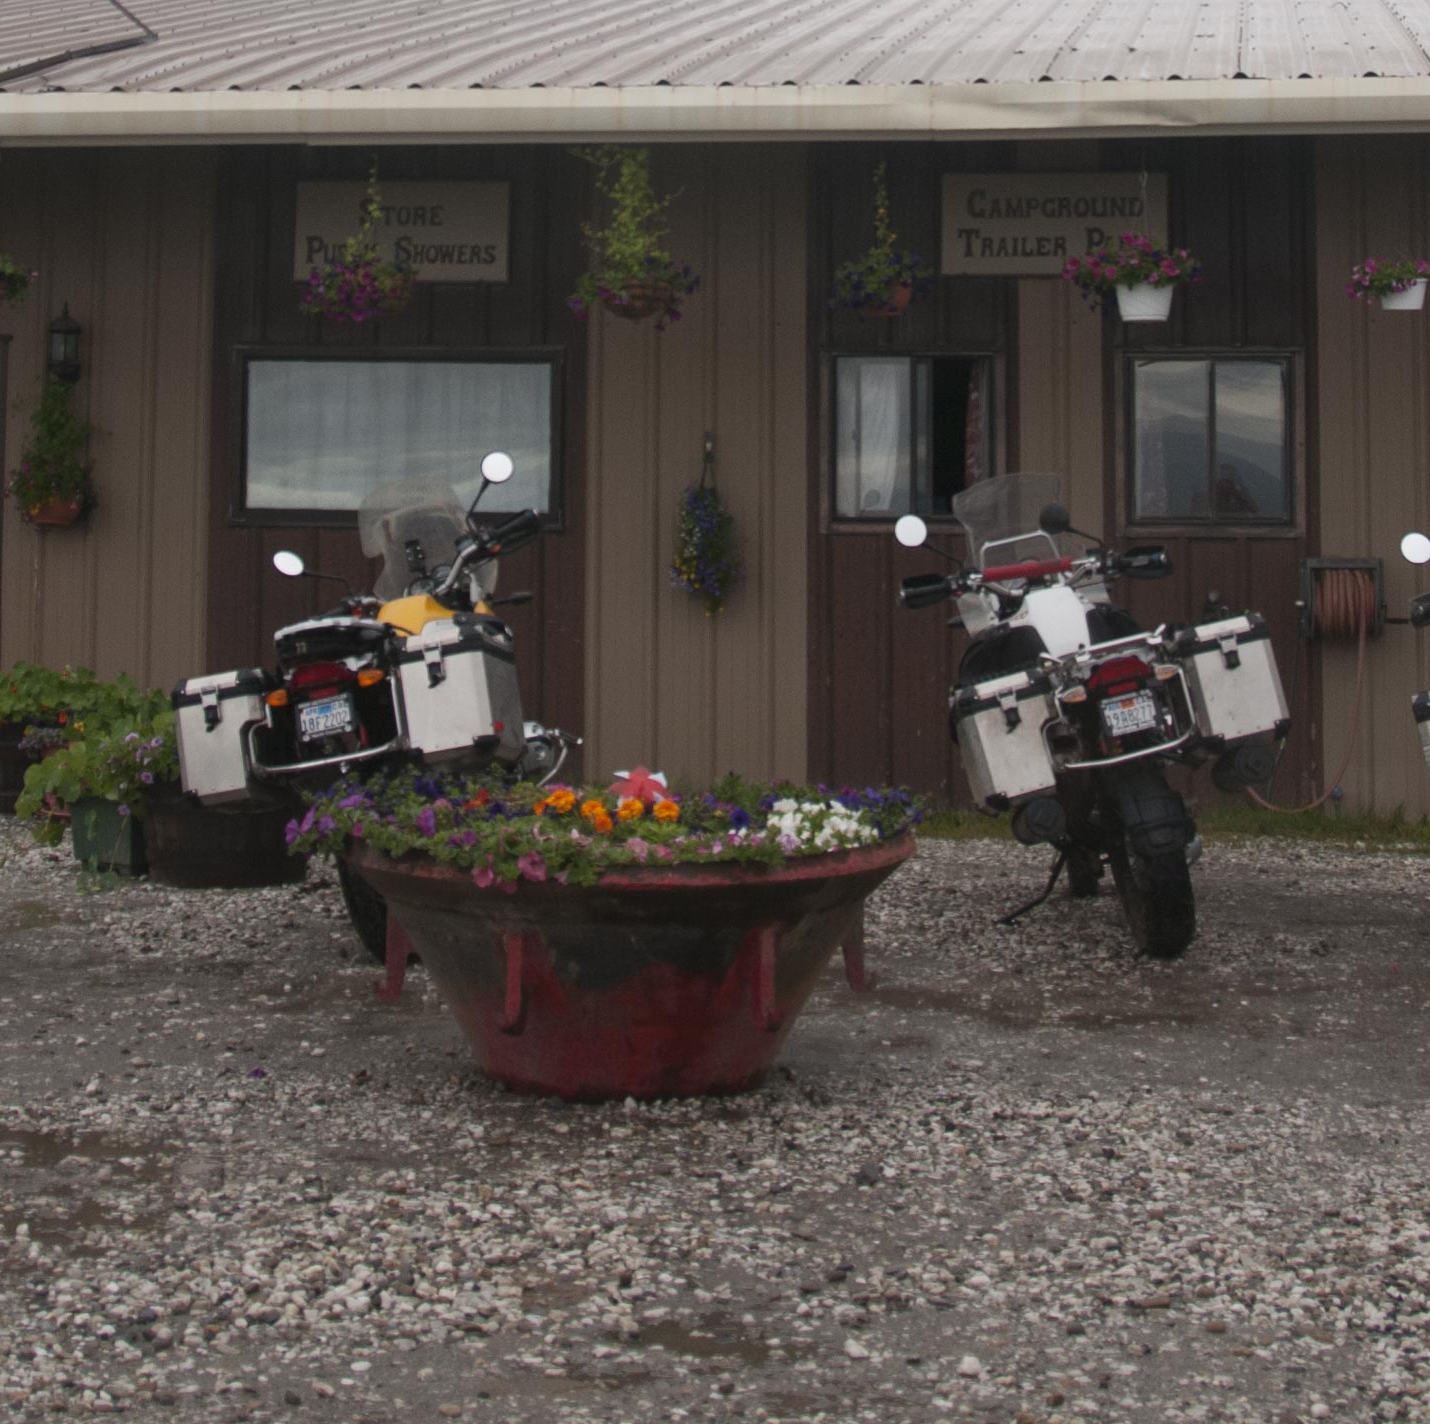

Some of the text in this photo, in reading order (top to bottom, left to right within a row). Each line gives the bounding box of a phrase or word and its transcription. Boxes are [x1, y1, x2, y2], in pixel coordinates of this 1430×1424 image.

[358, 197, 444, 227] STORE
[966, 188, 1145, 220] CAMPGROUND
[395, 235, 497, 265] SHOWERS
[958, 227, 1067, 258] TRAILER
